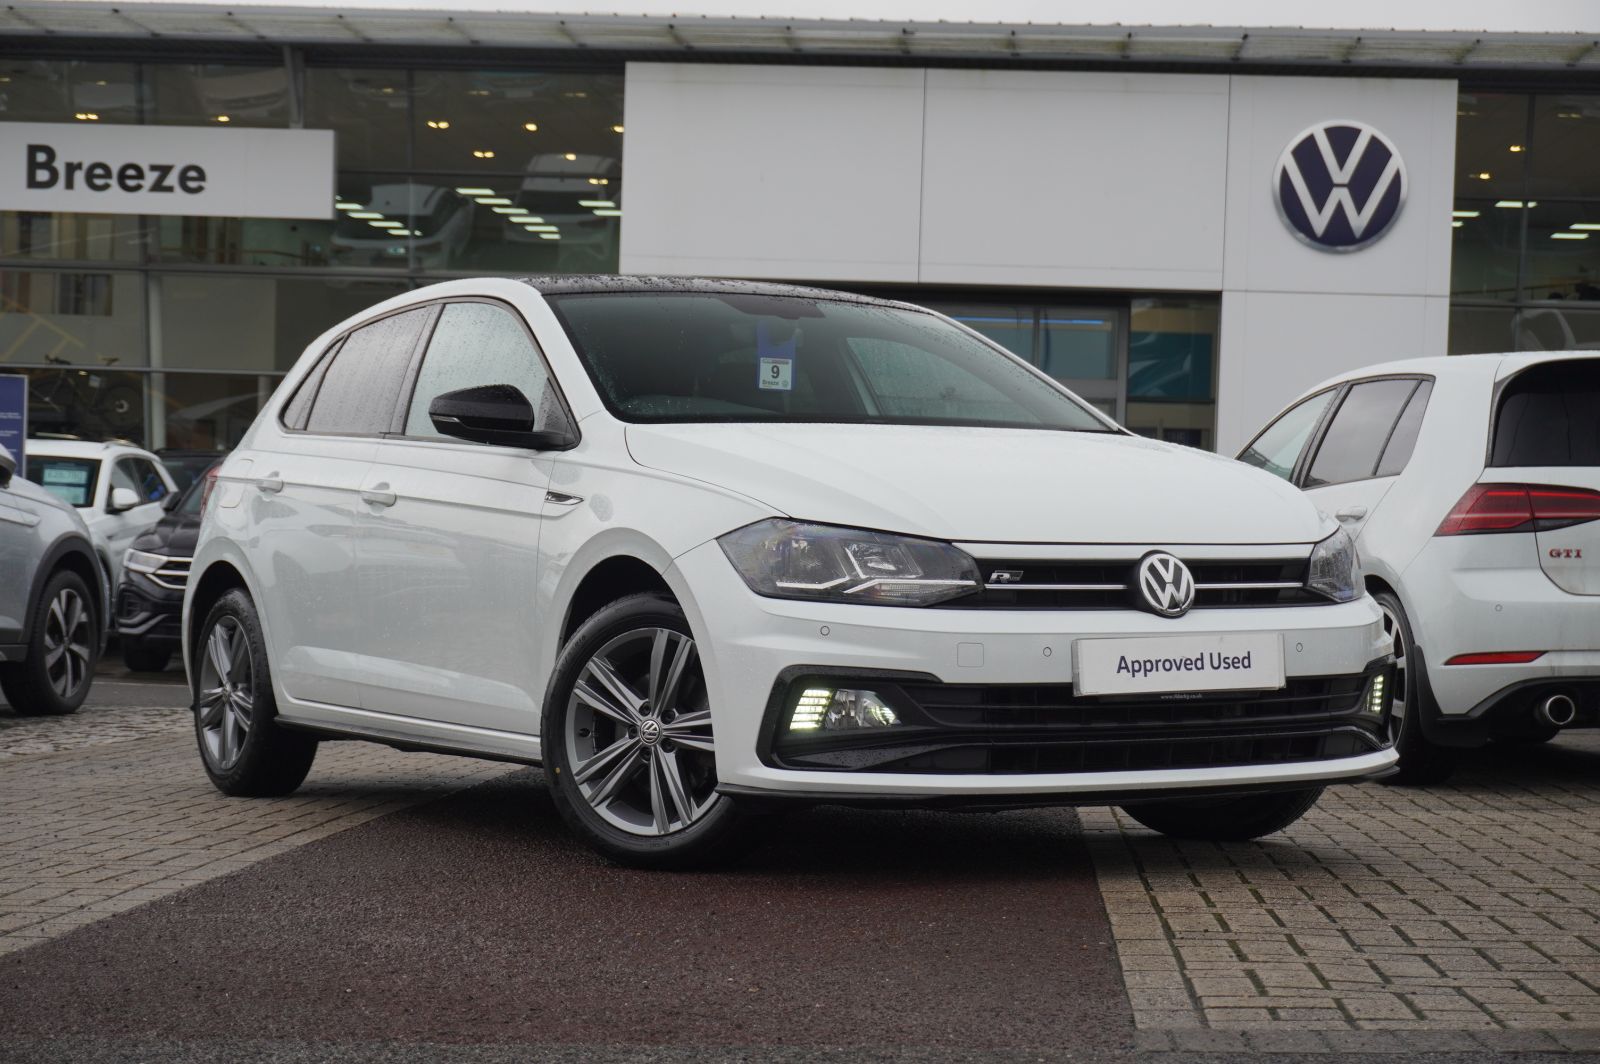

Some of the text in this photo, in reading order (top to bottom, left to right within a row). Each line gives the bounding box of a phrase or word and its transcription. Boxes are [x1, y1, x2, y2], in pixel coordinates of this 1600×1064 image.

[26, 143, 207, 195] Breeze
[771, 365, 780, 379] 9
[1548, 548, 1583, 560] GTI
[1116, 650, 1252, 678] Approved Used
